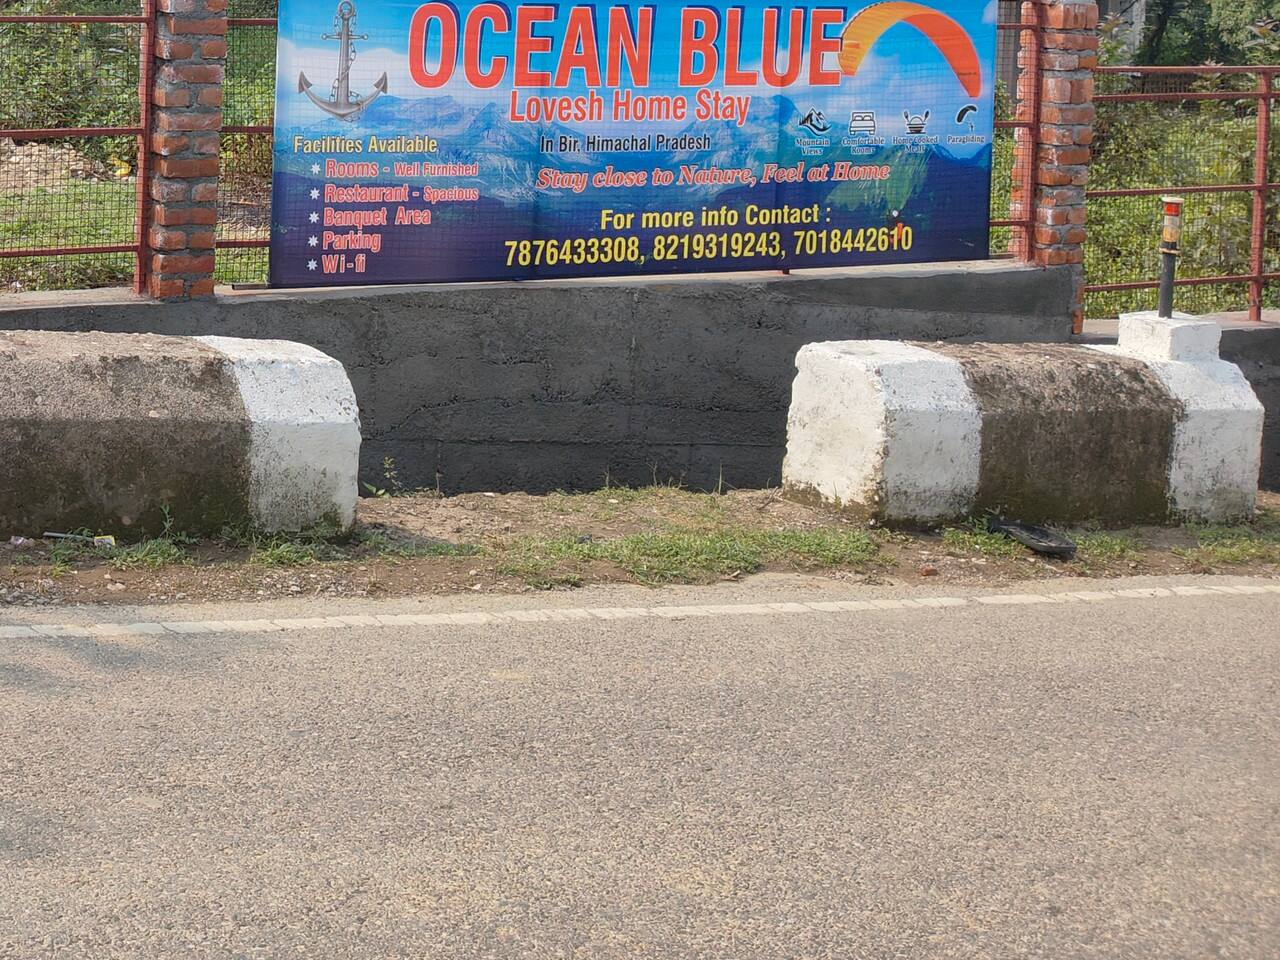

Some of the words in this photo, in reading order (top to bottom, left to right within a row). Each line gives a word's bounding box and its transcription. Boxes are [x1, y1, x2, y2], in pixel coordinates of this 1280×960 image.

[408, 1, 654, 89] OCEAN
[678, 5, 846, 88] BLUE
[510, 89, 603, 122] Lovesh
[612, 89, 687, 121] Home
[696, 88, 751, 127] Stay
[293, 135, 363, 153] Facilities
[367, 135, 438, 153] Available
[540, 136, 553, 153] In
[586, 134, 651, 152] Himachal
[656, 133, 711, 151] Pradesh
[795, 138, 830, 147] Mountain
[842, 136, 885, 146] Comfortable
[892, 136, 912, 145] Home
[947, 134, 985, 144] Paragliding
[802, 147, 823, 155] Views
[851, 146, 876, 154] Rooms
[905, 145, 926, 153] Meals
[325, 159, 378, 178] Rooms
[394, 162, 419, 176] Well
[423, 161, 479, 176] Furnished
[536, 167, 589, 193] Stay
[592, 165, 648, 189] close
[652, 167, 674, 187] to
[677, 163, 757, 188] Nature,
[761, 161, 804, 184] Feel
[807, 165, 829, 182] at
[831, 160, 890, 181] Home
[324, 183, 409, 203] Restaurant
[423, 185, 480, 204] Spacious
[323, 207, 388, 228] Banquet
[394, 206, 431, 225] Area
[600, 209, 635, 230] For
[641, 209, 695, 229] more
[701, 205, 738, 227] info
[745, 203, 820, 225] Contact
[322, 231, 381, 252] Parking
[504, 236, 646, 266] 7876433308,
[652, 231, 786, 262] 8219319243,
[793, 226, 913, 255] 7018442610
[322, 254, 366, 273] Wi-fi
